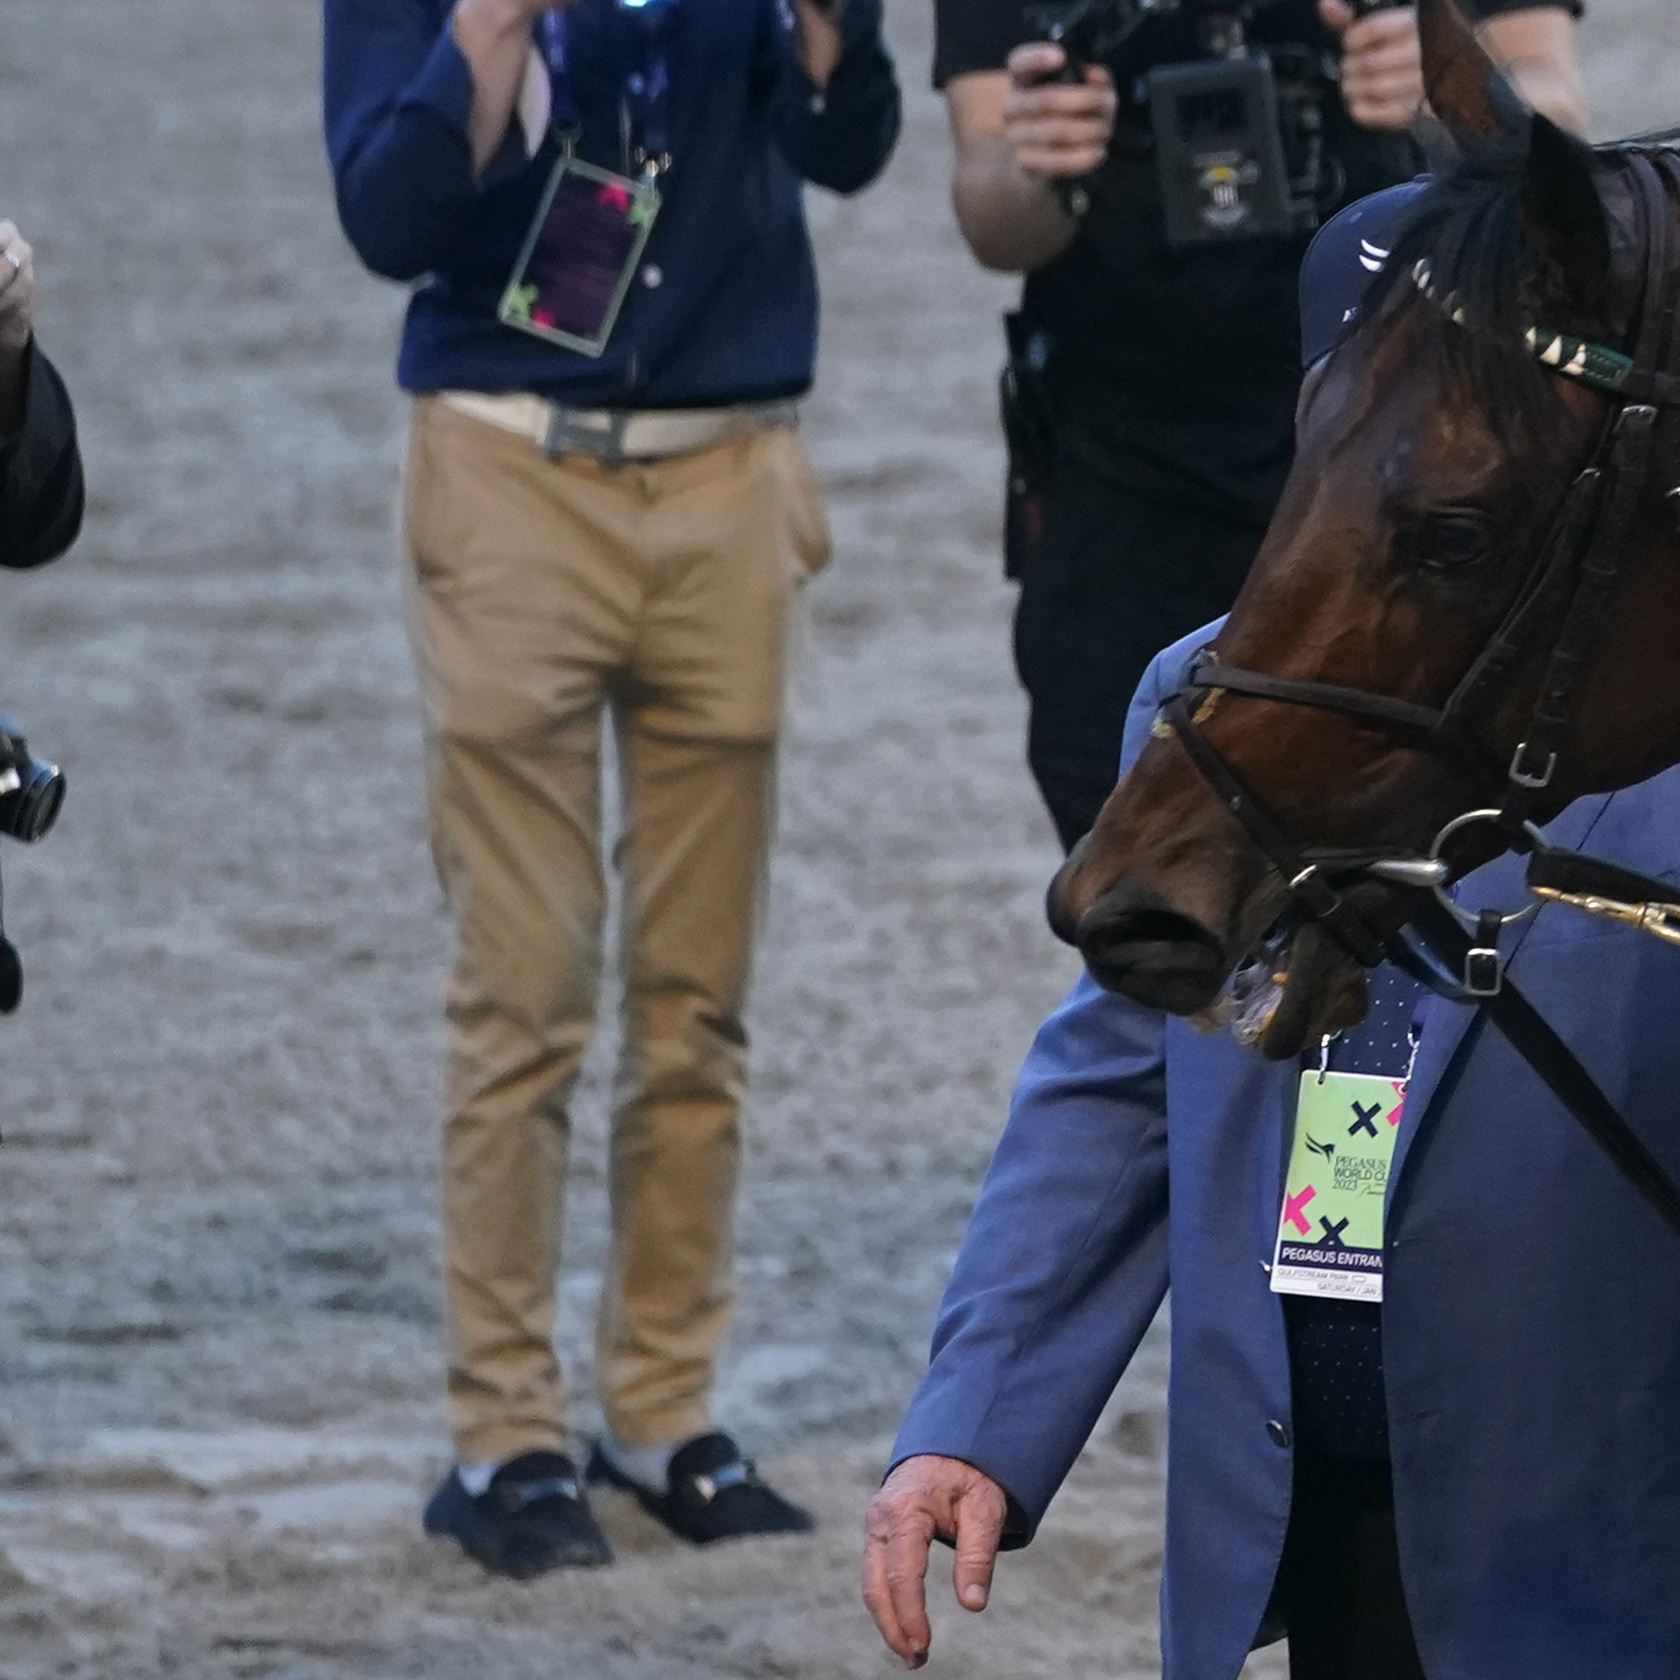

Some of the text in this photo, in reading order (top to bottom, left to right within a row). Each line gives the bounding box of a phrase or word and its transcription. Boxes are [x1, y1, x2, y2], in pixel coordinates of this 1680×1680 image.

[1334, 1155, 1386, 1170] PEGASUS
[1333, 1166, 1373, 1180] WORLD
[1281, 1247, 1383, 1268] PEGASUS ENTRAN
